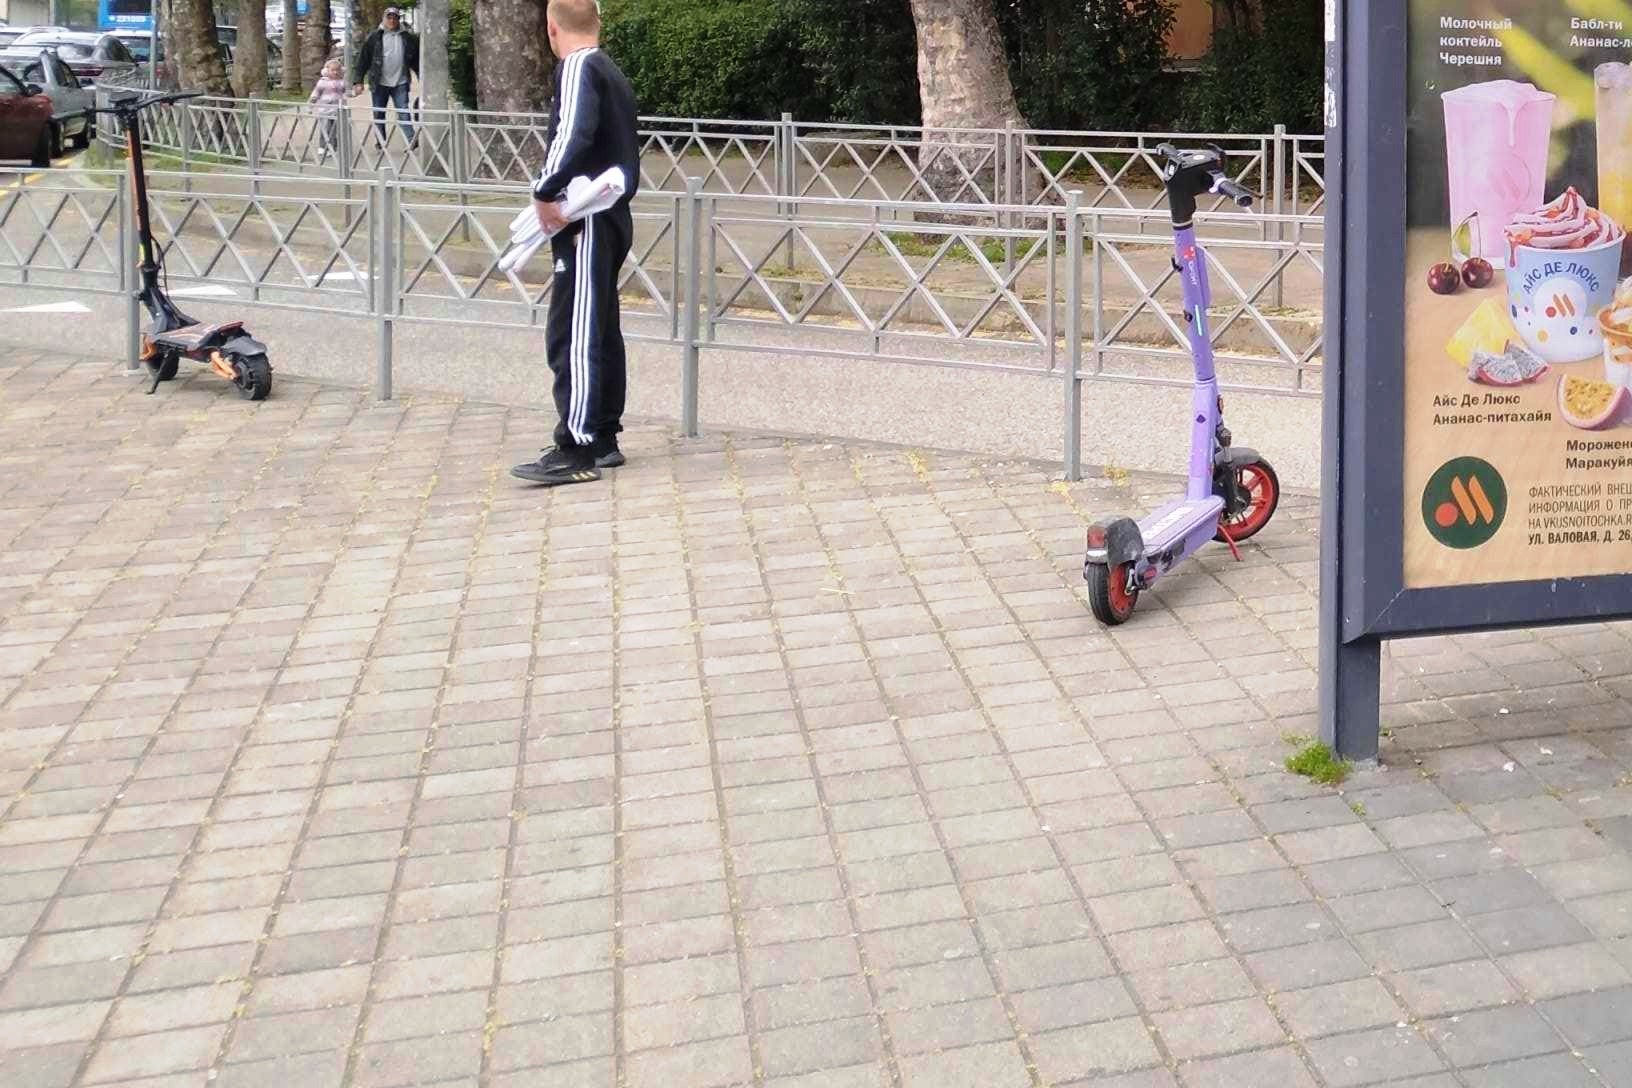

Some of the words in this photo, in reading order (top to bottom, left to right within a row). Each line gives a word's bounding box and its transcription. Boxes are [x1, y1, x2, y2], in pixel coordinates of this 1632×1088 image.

[1440, 16, 1513, 31] Молочный
[1570, 17, 1623, 31] Бабл-ти
[1439, 33, 1502, 48] коктейль
[1439, 52, 1502, 66] Черешня
[1522, 268, 1542, 294] АЙС
[1544, 261, 1562, 277] ДЕ
[1566, 262, 1600, 292] ЛЮКС
[1433, 394, 1458, 407] Айс
[1461, 394, 1480, 407] Де
[1482, 392, 1521, 405] Люкс
[1433, 409, 1552, 425] Ананас-питахайя
[1528, 482, 1602, 498] ФАКТИЧЕСКИЙ
[1528, 499, 1600, 514] ИНФОРМАЦИЯ
[1606, 498, 1613, 511] О
[1528, 517, 1541, 529] НА
[1528, 533, 1544, 546] УЛ.
[1547, 531, 1599, 545] ВАЛОВАЯ,
[1602, 530, 1615, 544] Д.
[1618, 529, 1632, 542] 26,
